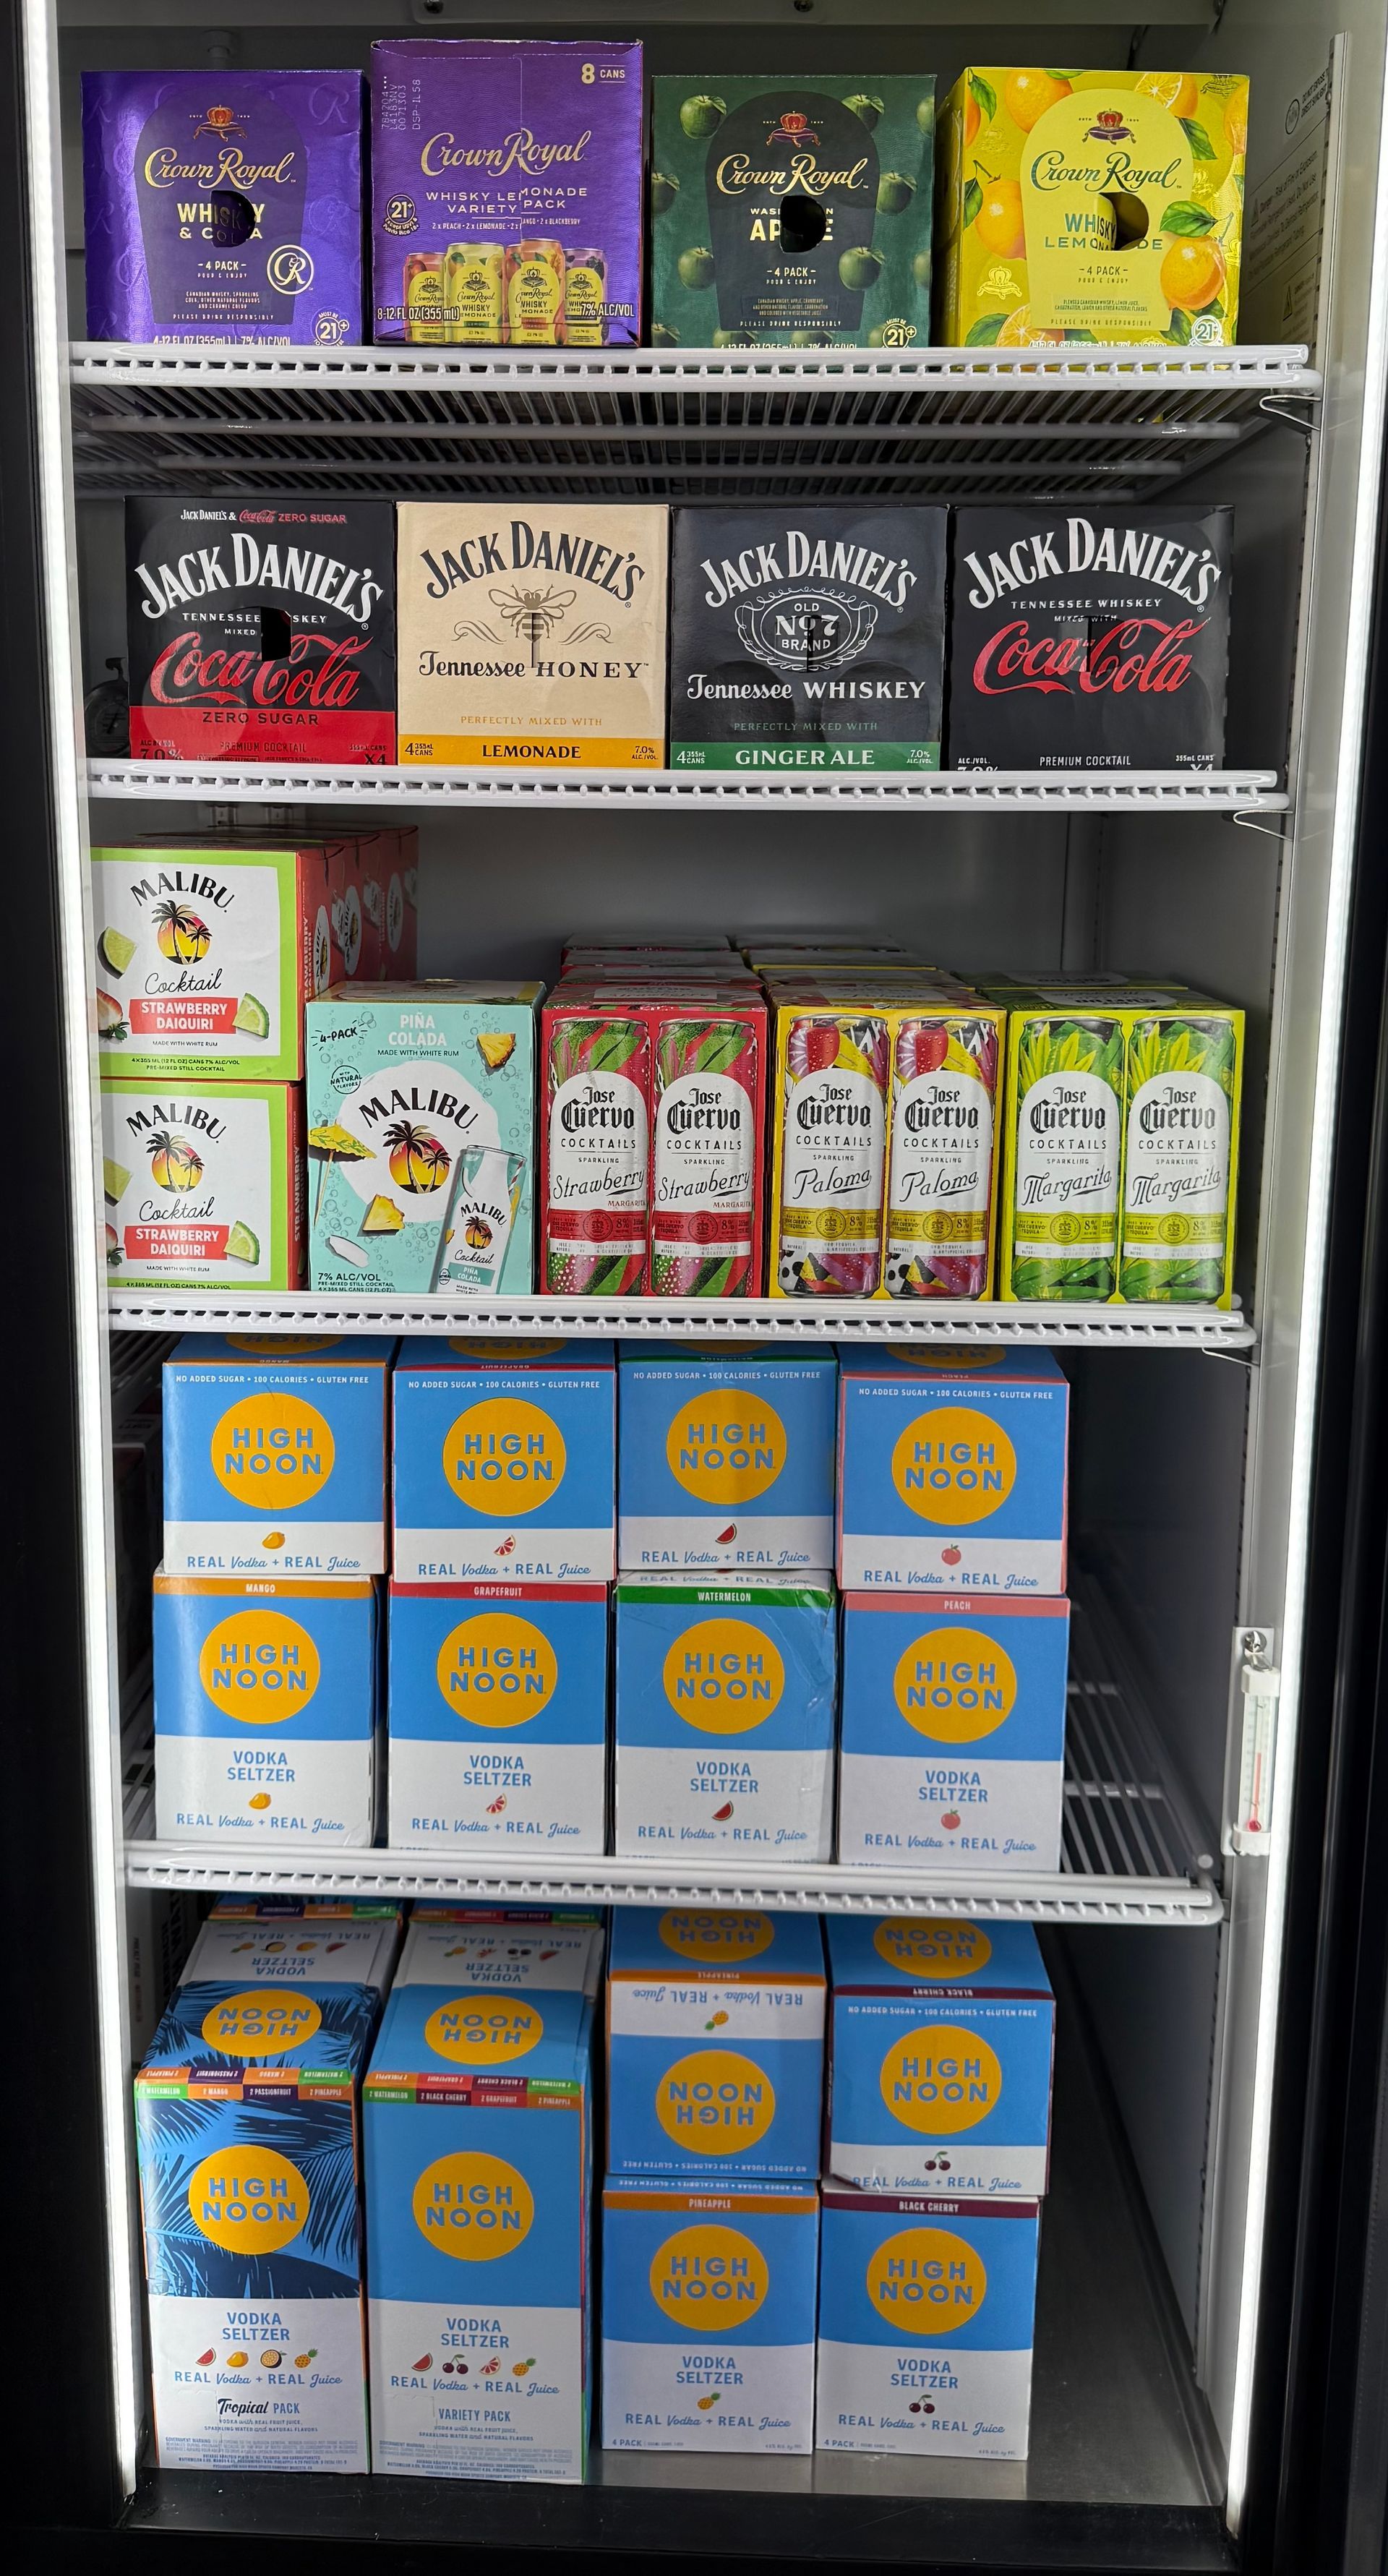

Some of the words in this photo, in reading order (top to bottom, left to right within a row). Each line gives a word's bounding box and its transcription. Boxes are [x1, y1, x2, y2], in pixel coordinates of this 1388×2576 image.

[581, 64, 595, 84] 8
[600, 69, 625, 78] CANS
[421, 132, 504, 176] Crown
[487, 128, 591, 176] Royal
[145, 147, 214, 188] Crown
[198, 147, 295, 189] Royal
[716, 153, 785, 194] Crown
[769, 153, 868, 195] Royal
[1031, 151, 1101, 191] Crown
[1094, 151, 1182, 192] Royal
[426, 192, 490, 202] WHISKY
[447, 204, 518, 214] VARIETY
[523, 199, 565, 209] PACK
[377, 308, 395, 320] 8-12
[397, 307, 407, 320] FL
[581, 305, 596, 316] 7%
[598, 305, 634, 317] ALC/VOL
[181, 510, 198, 521] JACK
[199, 510, 226, 521] DANIEL'S
[228, 511, 236, 521] &
[278, 513, 307, 522] ZERO
[309, 514, 347, 523] SUGAR
[420, 533, 507, 599] JACK
[510, 521, 645, 601] DANIEL'S
[701, 543, 784, 607] JACK
[787, 531, 917, 607] DANIEL'S
[964, 531, 1063, 609] JACK
[1066, 518, 1222, 605] DANIEL'S
[134, 546, 231, 619] JACK
[231, 533, 383, 622] DANIEL'S
[1098, 599, 1161, 608] WHISKEY
[781, 640, 831, 650] BRAND
[419, 651, 525, 676] Tennessee
[536, 662, 641, 677] HONEY
[687, 674, 792, 699] Tennessee
[803, 682, 925, 698] WHISKEY
[202, 712, 249, 723] ZERO
[258, 713, 319, 724] SUGAR
[461, 716, 522, 724] PERFECTLY
[528, 716, 567, 725] MIXED
[573, 717, 602, 726] WITH
[482, 745, 581, 758] LEMONADE
[735, 750, 828, 765] GINGER
[831, 750, 874, 765] ALE
[1040, 757, 1081, 766] PREMIUM
[1086, 756, 1131, 766] COCKTAIL
[130, 871, 234, 910] MALIBU
[145, 968, 222, 995] Cocktail
[142, 1001, 227, 1017] STRAWBERRY
[156, 1017, 213, 1030] DAIQUIRI
[400, 1013, 435, 1029] PIÑA
[320, 1027, 357, 1043] 4-PACK
[388, 1032, 447, 1046] COLADA
[583, 1086, 615, 1105] Jose
[689, 1088, 721, 1106] Jose
[819, 1084, 852, 1103] Jose
[928, 1085, 960, 1104] Jose
[1053, 1087, 1087, 1105] Jose
[1163, 1087, 1196, 1105] Jose
[359, 1088, 479, 1129] MALIBU
[561, 1100, 634, 1131] Cuervo
[667, 1102, 740, 1134] Cuervo
[797, 1096, 871, 1130] Cuervo
[905, 1097, 978, 1132] Cuervo
[1030, 1100, 1105, 1134] Cuervo
[1140, 1100, 1215, 1134] Cuervo
[126, 1103, 226, 1139] MALIBU
[562, 1138, 636, 1149] COCKTAILS
[667, 1140, 742, 1150] COCKTAILS
[797, 1136, 871, 1147] COCKTAILS
[904, 1138, 978, 1149] COCKTAILS
[1029, 1139, 1106, 1150] COCKTAILS
[1139, 1139, 1216, 1150] COCKTAILS
[554, 1168, 644, 1199] Strawberry
[659, 1169, 750, 1202] Strawberry
[792, 1168, 871, 1199] Paloma
[899, 1170, 978, 1202] Paloma
[1021, 1168, 1111, 1205] Margarita
[1131, 1165, 1220, 1207] Margarita
[139, 1197, 215, 1222] Cocktail
[460, 1203, 507, 1225] MALIBU
[136, 1229, 218, 1242] STRAWBERRY
[150, 1244, 205, 1256] DAIQUIRI
[455, 1250, 494, 1264] Cocktail
[233, 1428, 313, 1449] HIGH
[465, 1434, 544, 1454] HIGH
[914, 1442, 994, 1464] HIGH
[226, 1453, 320, 1474] NOON
[458, 1460, 552, 1481] NOON
[906, 1468, 1002, 1491] NOON
[187, 1557, 225, 1567] REAL
[231, 1557, 267, 1568] Vodka
[285, 1557, 322, 1567] REAL
[327, 1557, 360, 1571] Juice
[246, 1584, 275, 1593] MANGO
[474, 1587, 522, 1596] GRAPEFRUIT
[698, 1592, 751, 1601] WATERMELON
[944, 1601, 970, 1610] PEACH
[220, 1643, 299, 1664] HIGH
[458, 1647, 536, 1669] HIGH
[213, 1669, 307, 1690] NOON
[916, 1661, 995, 1684] HIGH
[450, 1672, 544, 1694] NOON
[907, 1686, 1003, 1709] NOON
[234, 1751, 288, 1765] VODKA
[228, 1768, 295, 1781] SELTZER
[901, 2058, 980, 2078] HIGH
[894, 2081, 988, 2102] NOON
[209, 2178, 287, 2197] HIGH
[434, 2183, 513, 2206] HIGH
[203, 2201, 297, 2222] NOON
[689, 2199, 731, 2208] PINEAPPLE
[899, 2201, 925, 2211] BLACK
[928, 2202, 959, 2213] CHERRY
[426, 2207, 521, 2230] NOON
[671, 2256, 748, 2277] HIGH
[663, 2280, 755, 2301] NOON
[217, 2398, 269, 2416] Tropical
[274, 2403, 300, 2414] PACK
[439, 2408, 480, 2421] VARIETY
[484, 2410, 510, 2422] PACK
